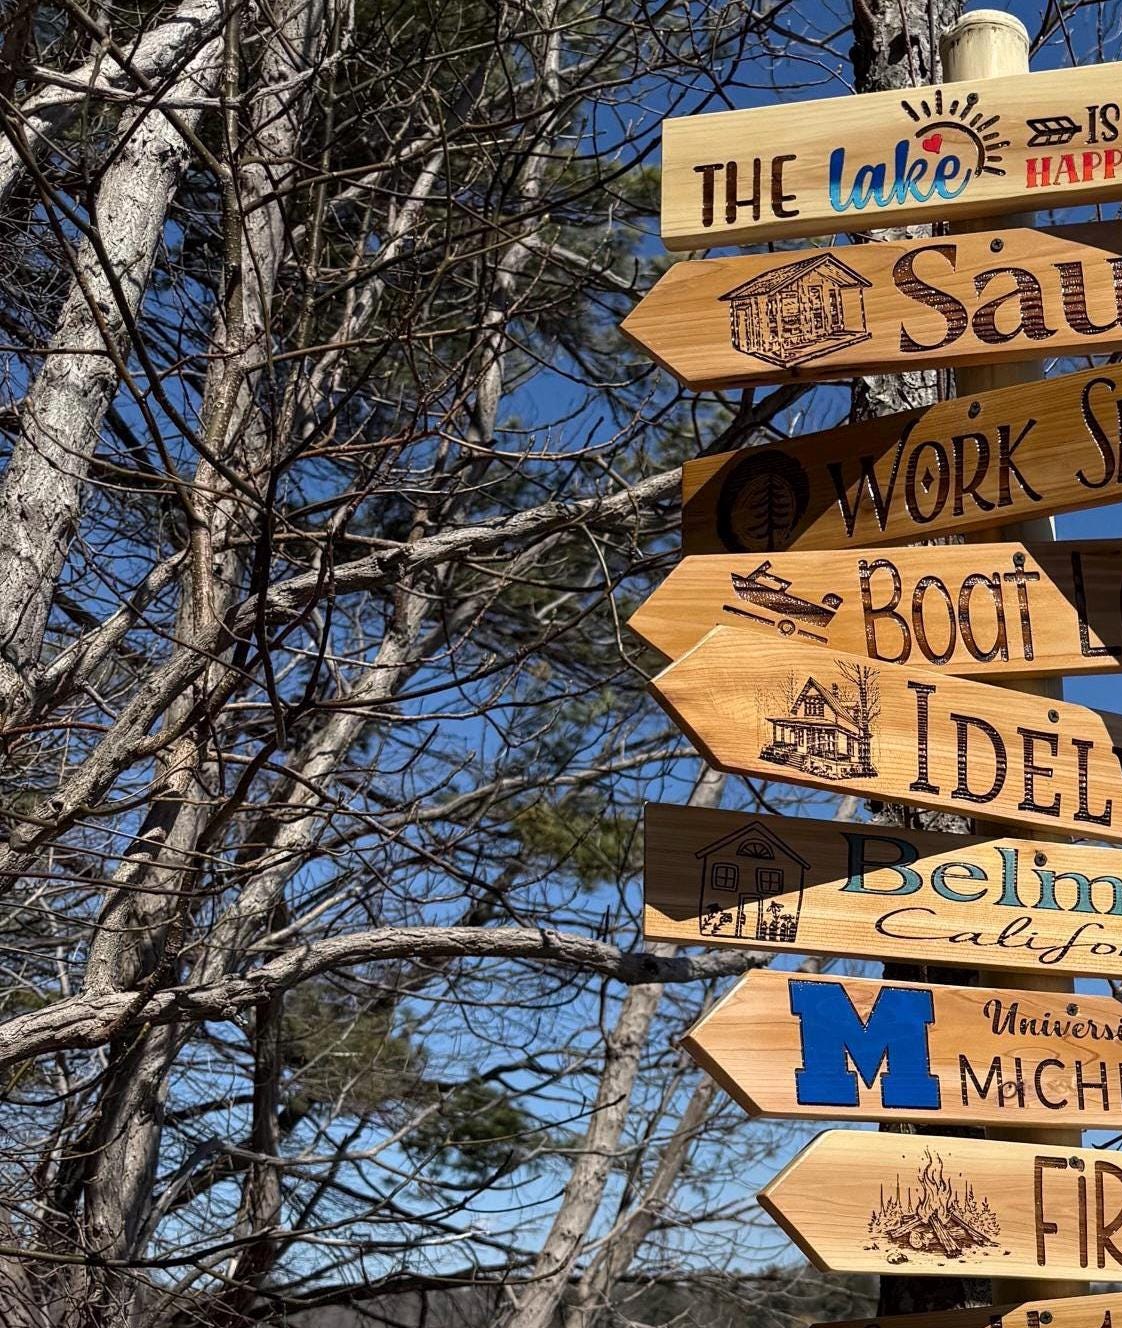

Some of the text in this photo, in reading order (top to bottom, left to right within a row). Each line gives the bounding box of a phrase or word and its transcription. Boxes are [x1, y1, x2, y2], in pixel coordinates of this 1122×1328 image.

[1086, 103, 1120, 144] IS
[693, 146, 974, 228] THE lake
[826, 417, 1043, 538] WORK
[858, 551, 1041, 665] Boat
[788, 980, 942, 1110] M
